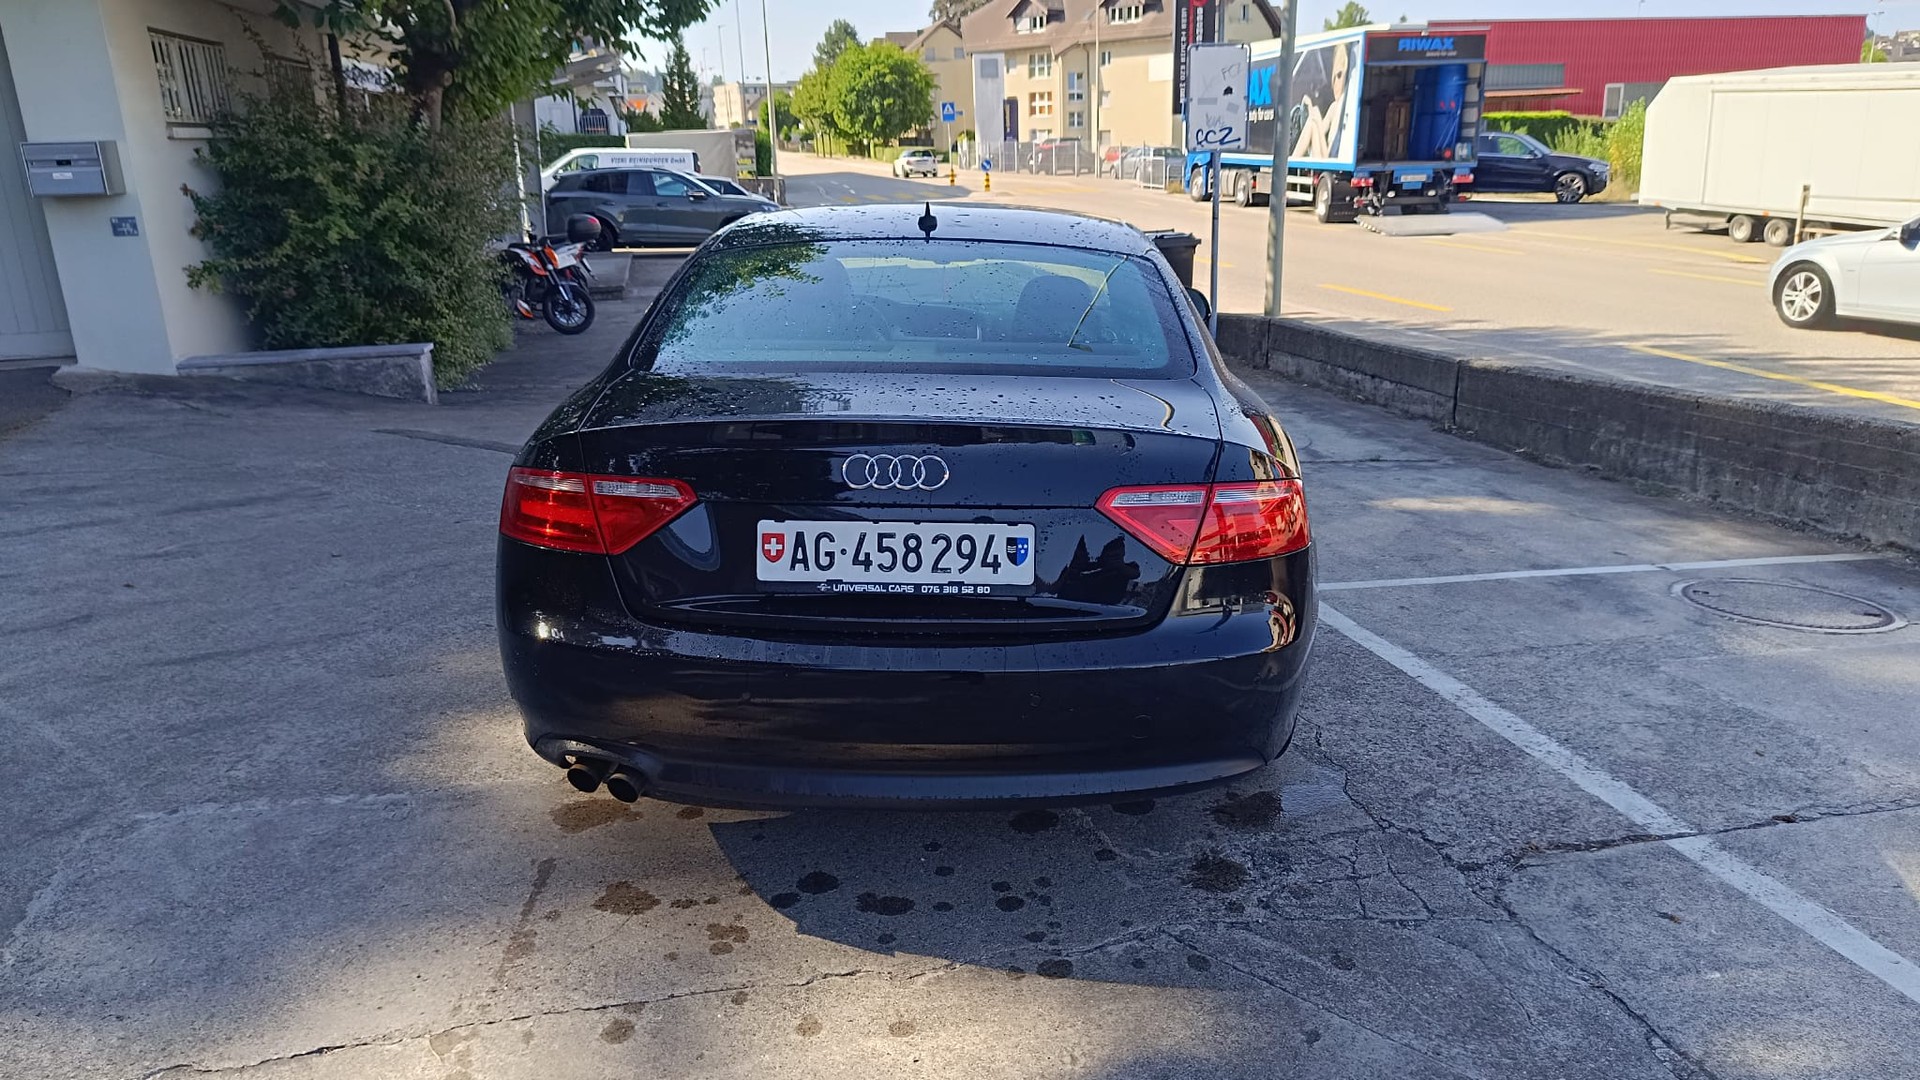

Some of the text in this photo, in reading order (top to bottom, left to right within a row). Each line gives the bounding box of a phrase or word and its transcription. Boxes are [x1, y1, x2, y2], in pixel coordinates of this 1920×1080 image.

[832, 583, 991, 594] UNIVERSAL CARS 076 318 52 80
